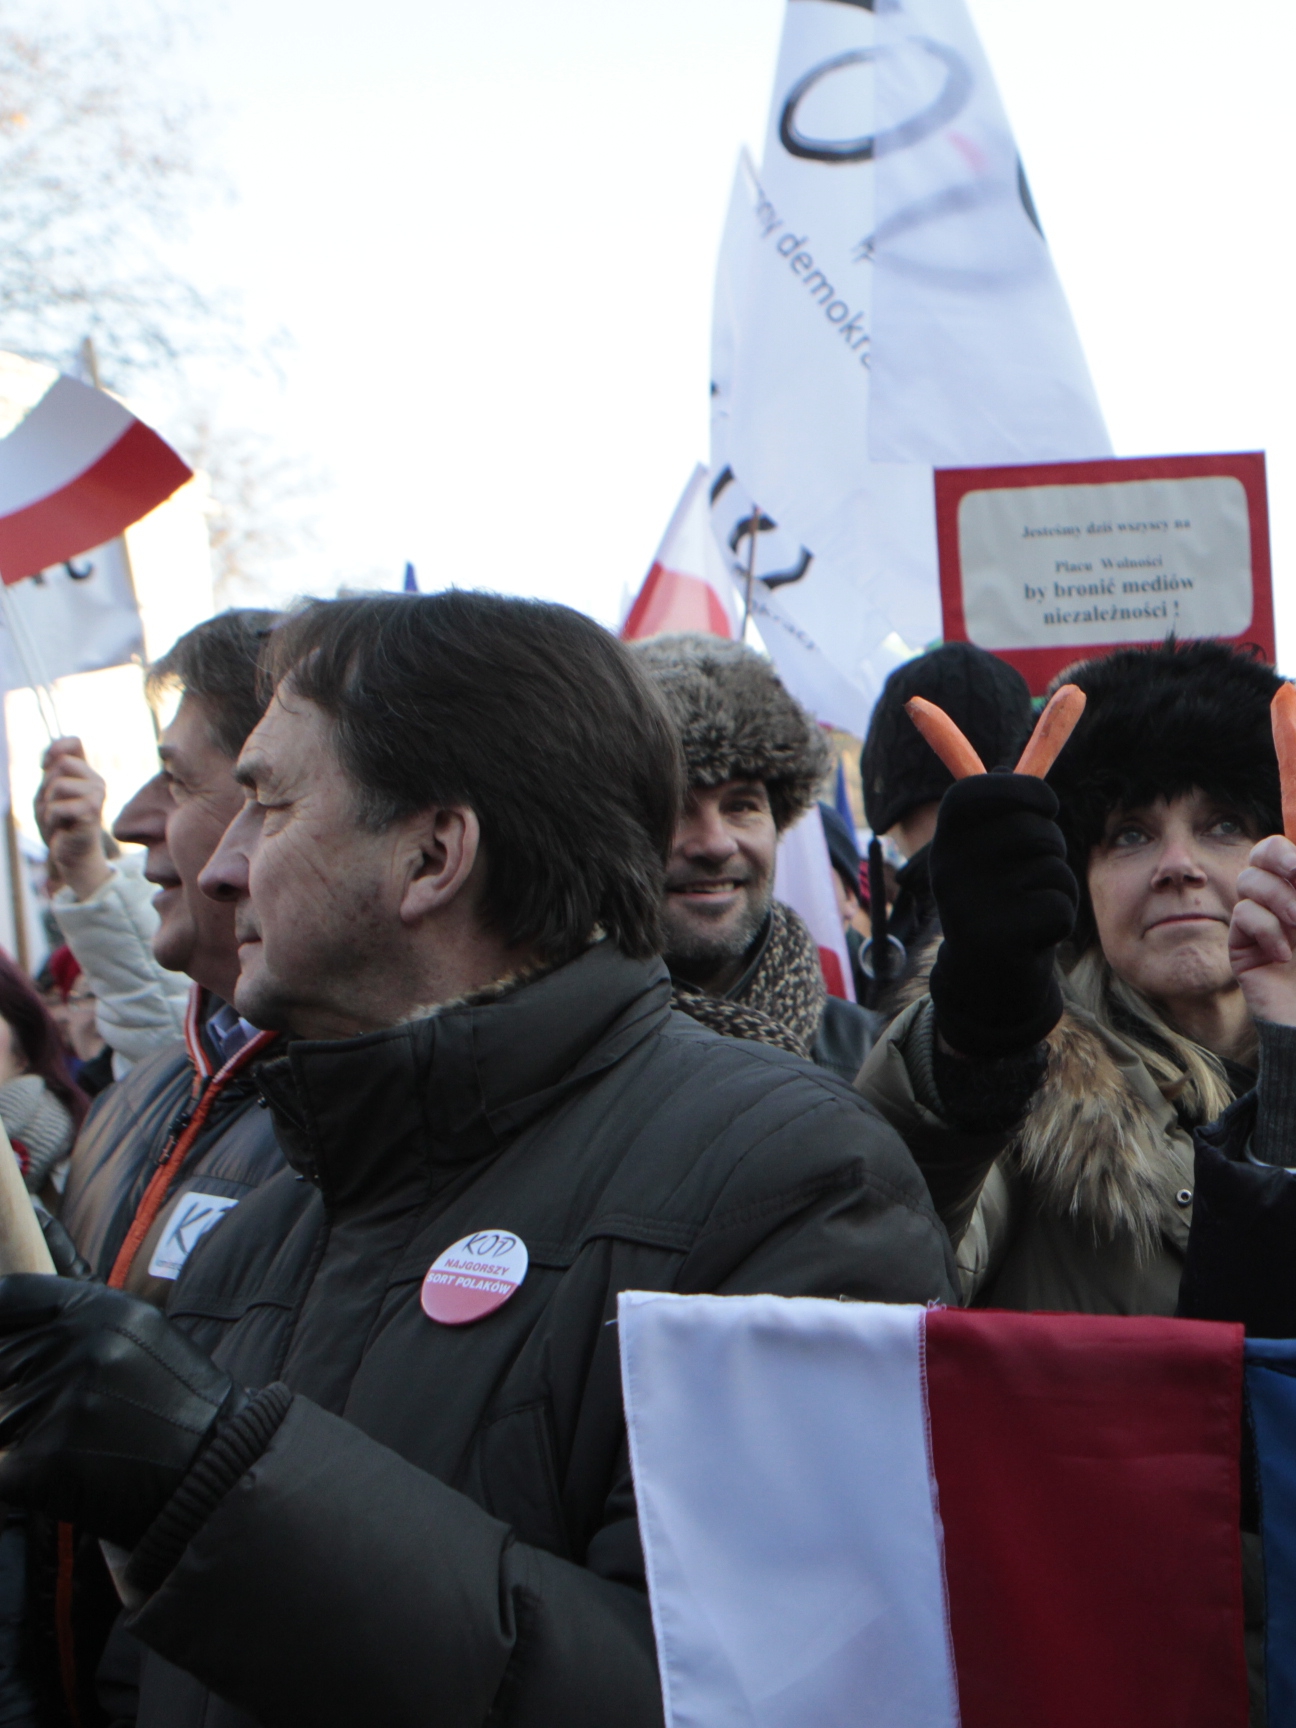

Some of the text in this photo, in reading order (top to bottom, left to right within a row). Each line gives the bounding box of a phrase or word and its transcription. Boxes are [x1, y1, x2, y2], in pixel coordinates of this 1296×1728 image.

[1021, 518, 1191, 539] Jesteśmy dziś wszyscy na
[1055, 554, 1163, 573] Placu Wolności
[1024, 574, 1195, 603] by bronić mediów
[1044, 603, 1168, 626] niezależności
[462, 1233, 517, 1258] KOD
[444, 1259, 511, 1276] NAJGORSZY
[427, 1272, 512, 1294] SORT POLAKÓW
